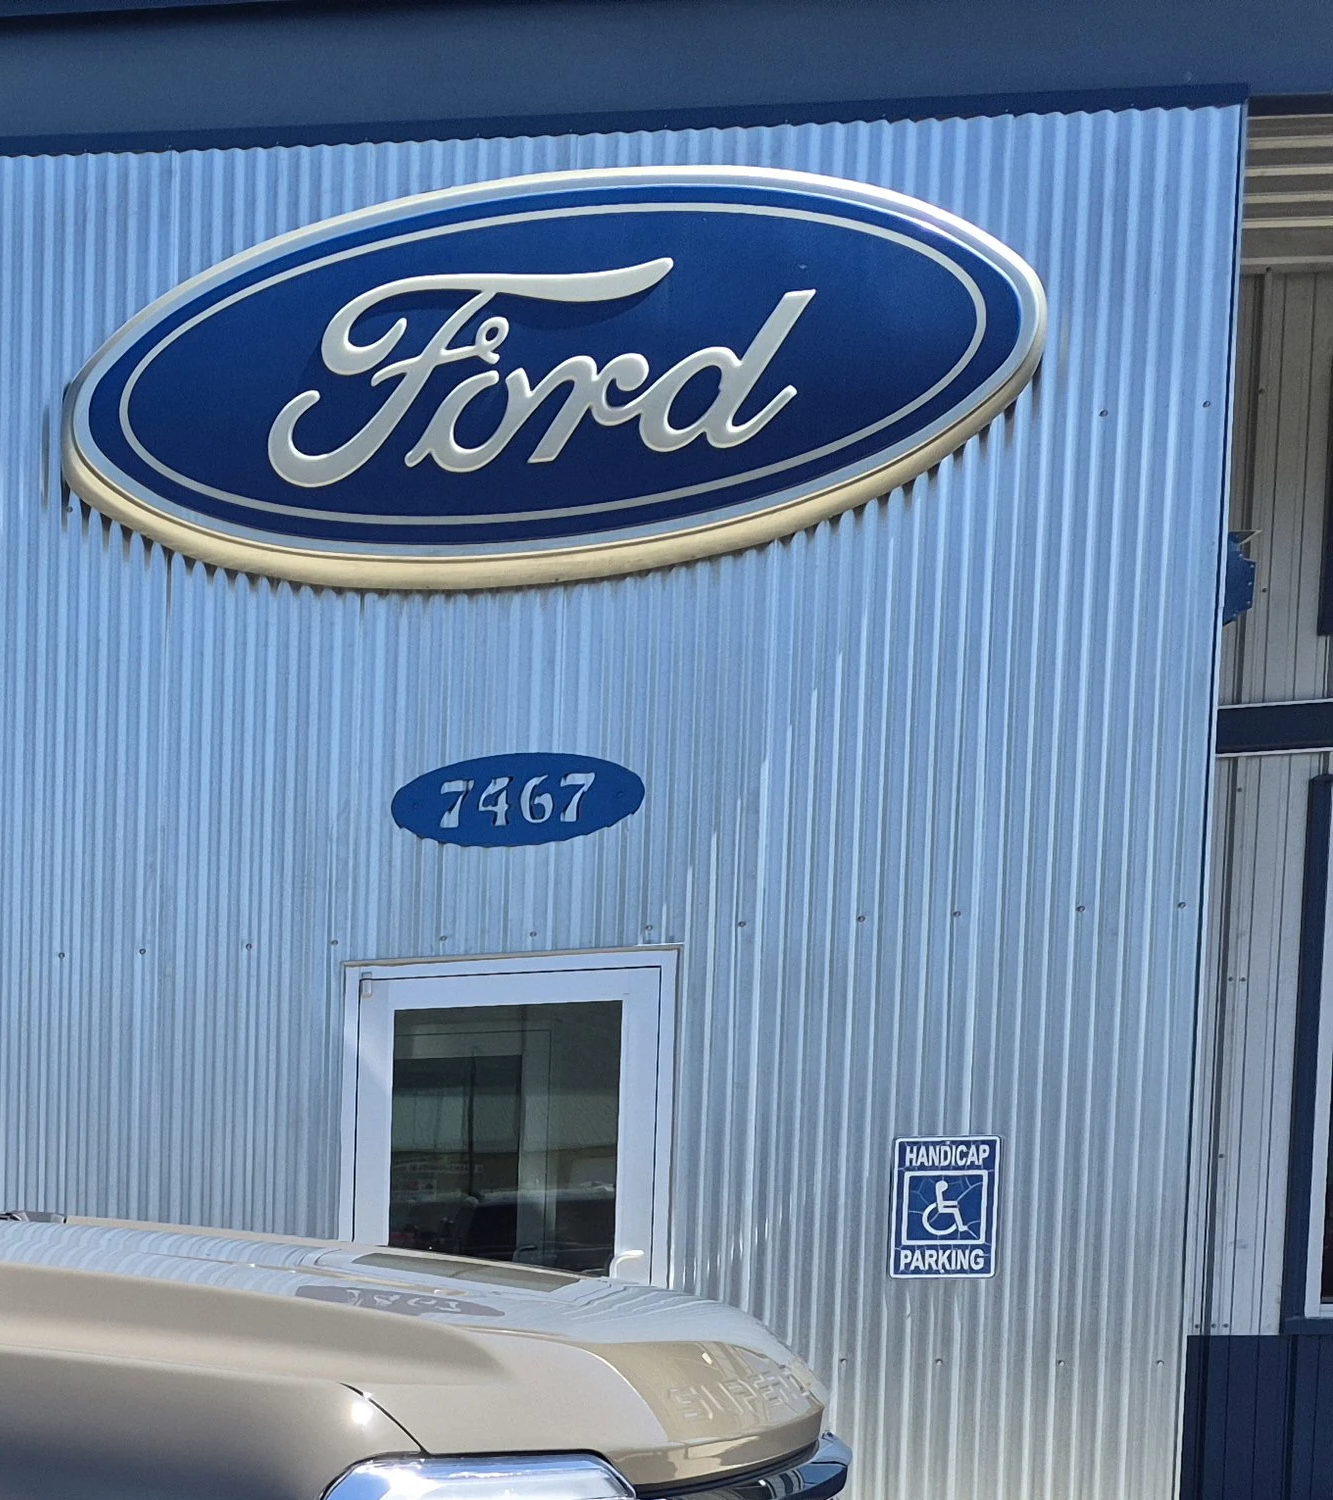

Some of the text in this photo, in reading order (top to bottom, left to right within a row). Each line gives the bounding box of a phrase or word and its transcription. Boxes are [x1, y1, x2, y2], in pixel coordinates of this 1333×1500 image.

[267, 256, 817, 488] Ford
[439, 771, 596, 829] 7467
[905, 1144, 990, 1167] HANDICAP
[899, 1248, 985, 1271] PARKING
